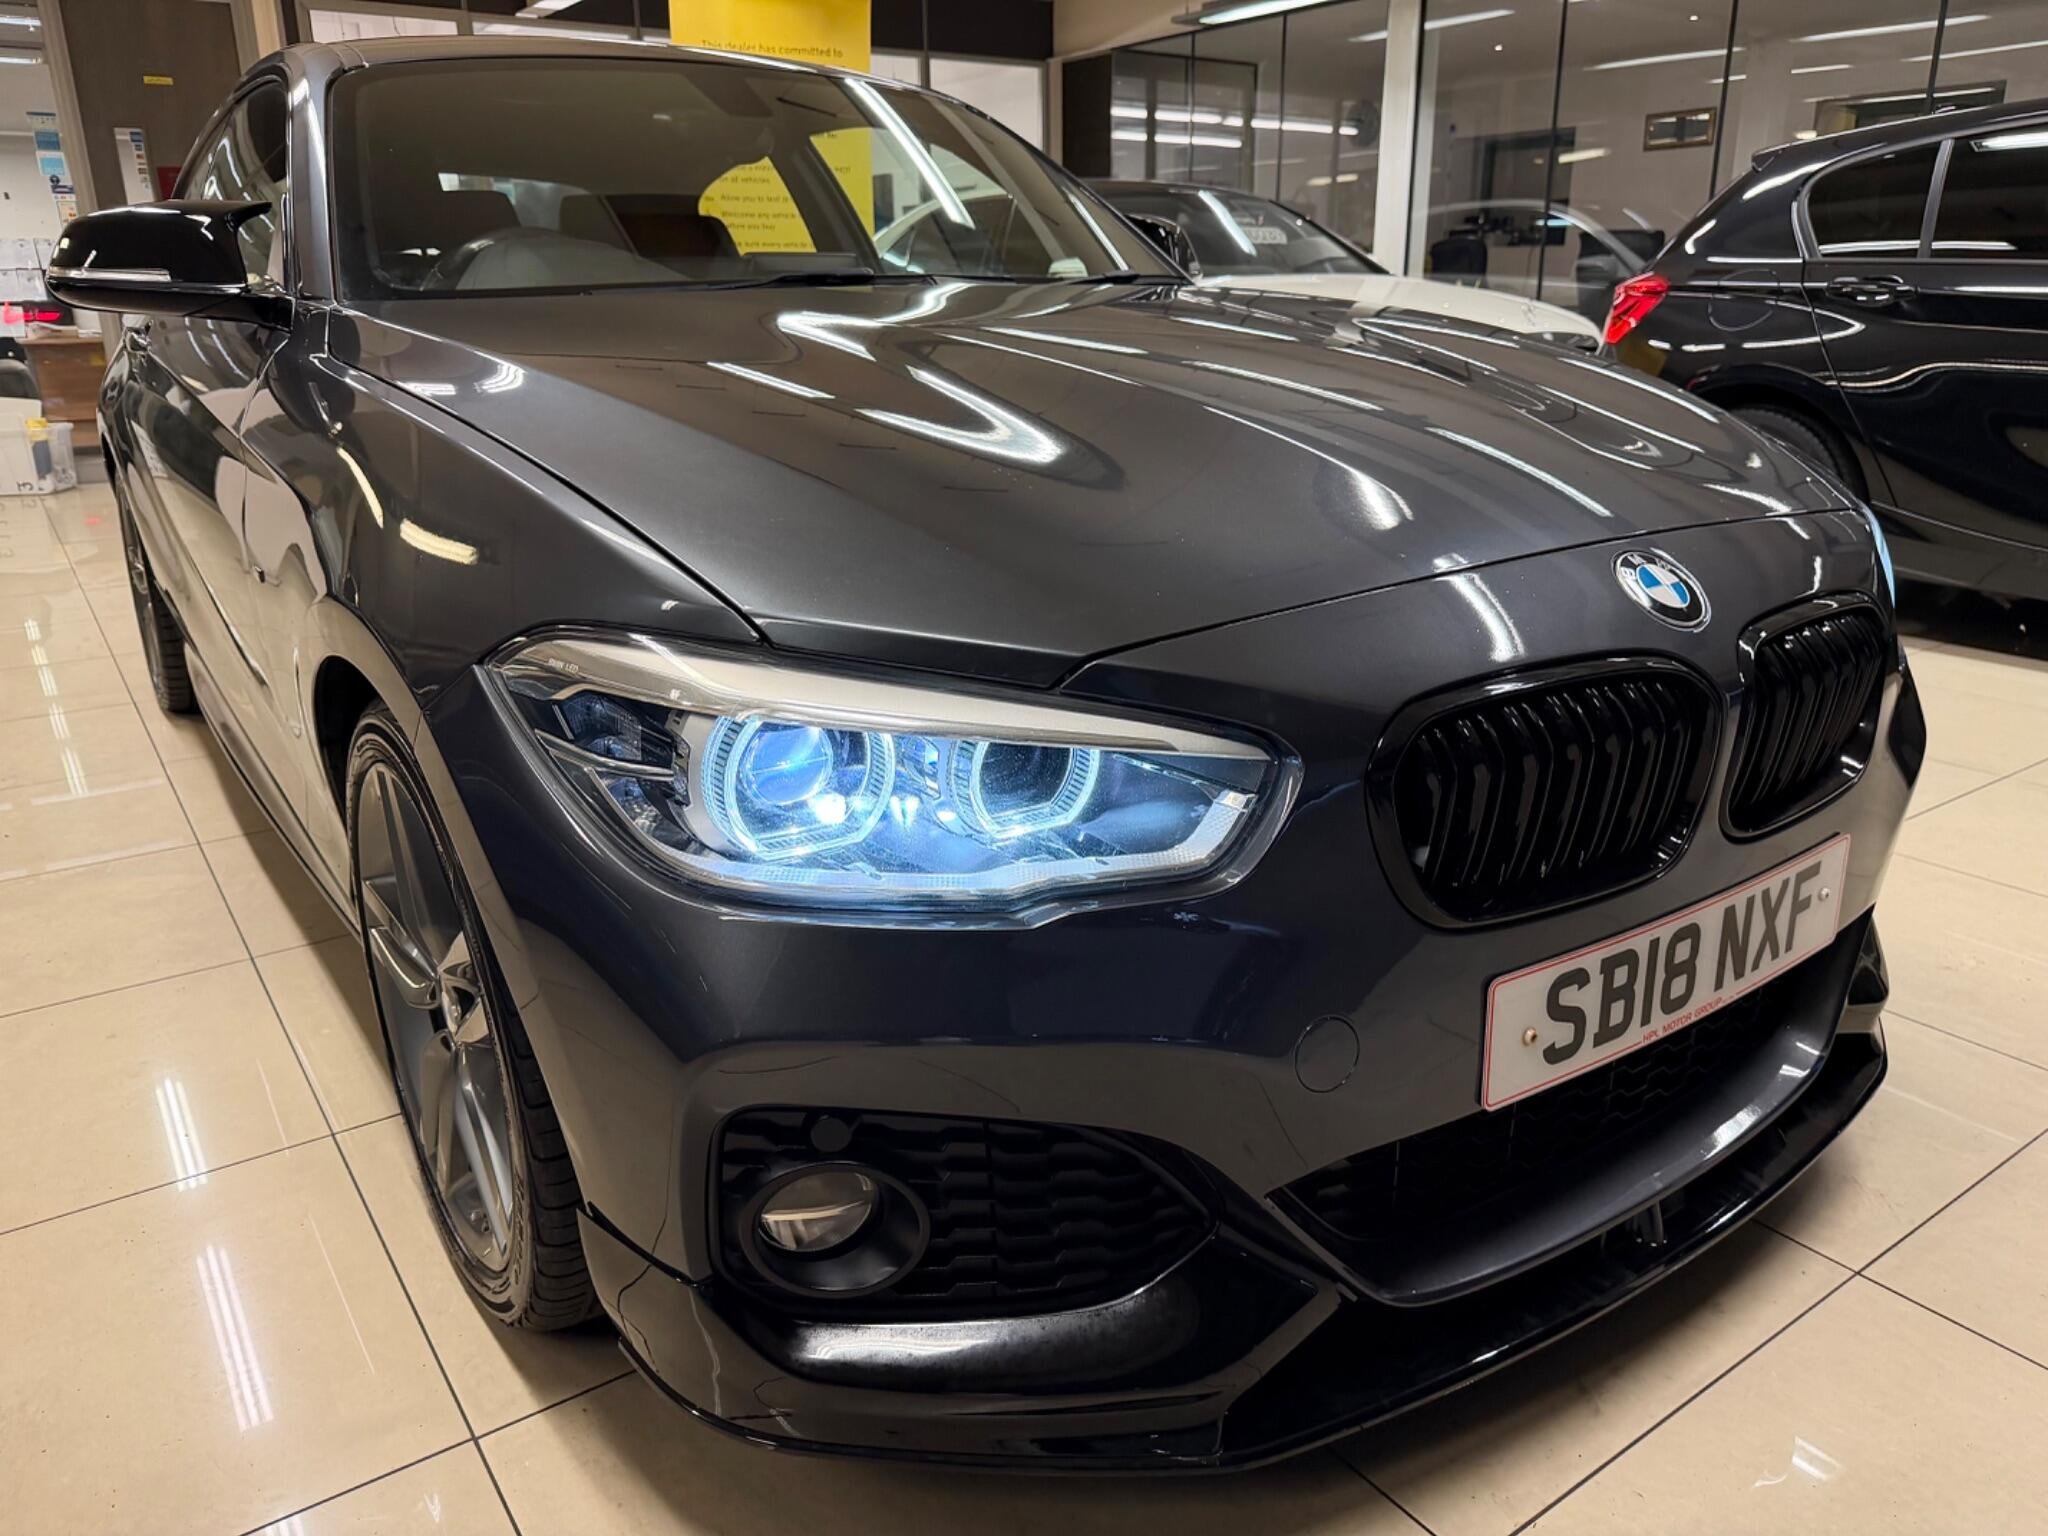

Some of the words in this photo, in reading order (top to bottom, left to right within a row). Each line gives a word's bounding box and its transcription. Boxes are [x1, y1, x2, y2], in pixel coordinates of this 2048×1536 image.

[702, 39, 722, 48] This
[725, 41, 756, 51] dealer
[758, 42, 777, 55] has
[779, 44, 831, 58] committed
[832, 47, 844, 59] to
[720, 194, 742, 203] Allow
[743, 196, 756, 204] you
[721, 211, 760, 220] Welcome
[1543, 922, 1702, 1066] SB18
[1713, 860, 1823, 993] NXF
[1642, 1030, 1661, 1044] HPL
[1662, 1012, 1692, 1033] MOTOR
[1694, 996, 1724, 1018] GROUP
